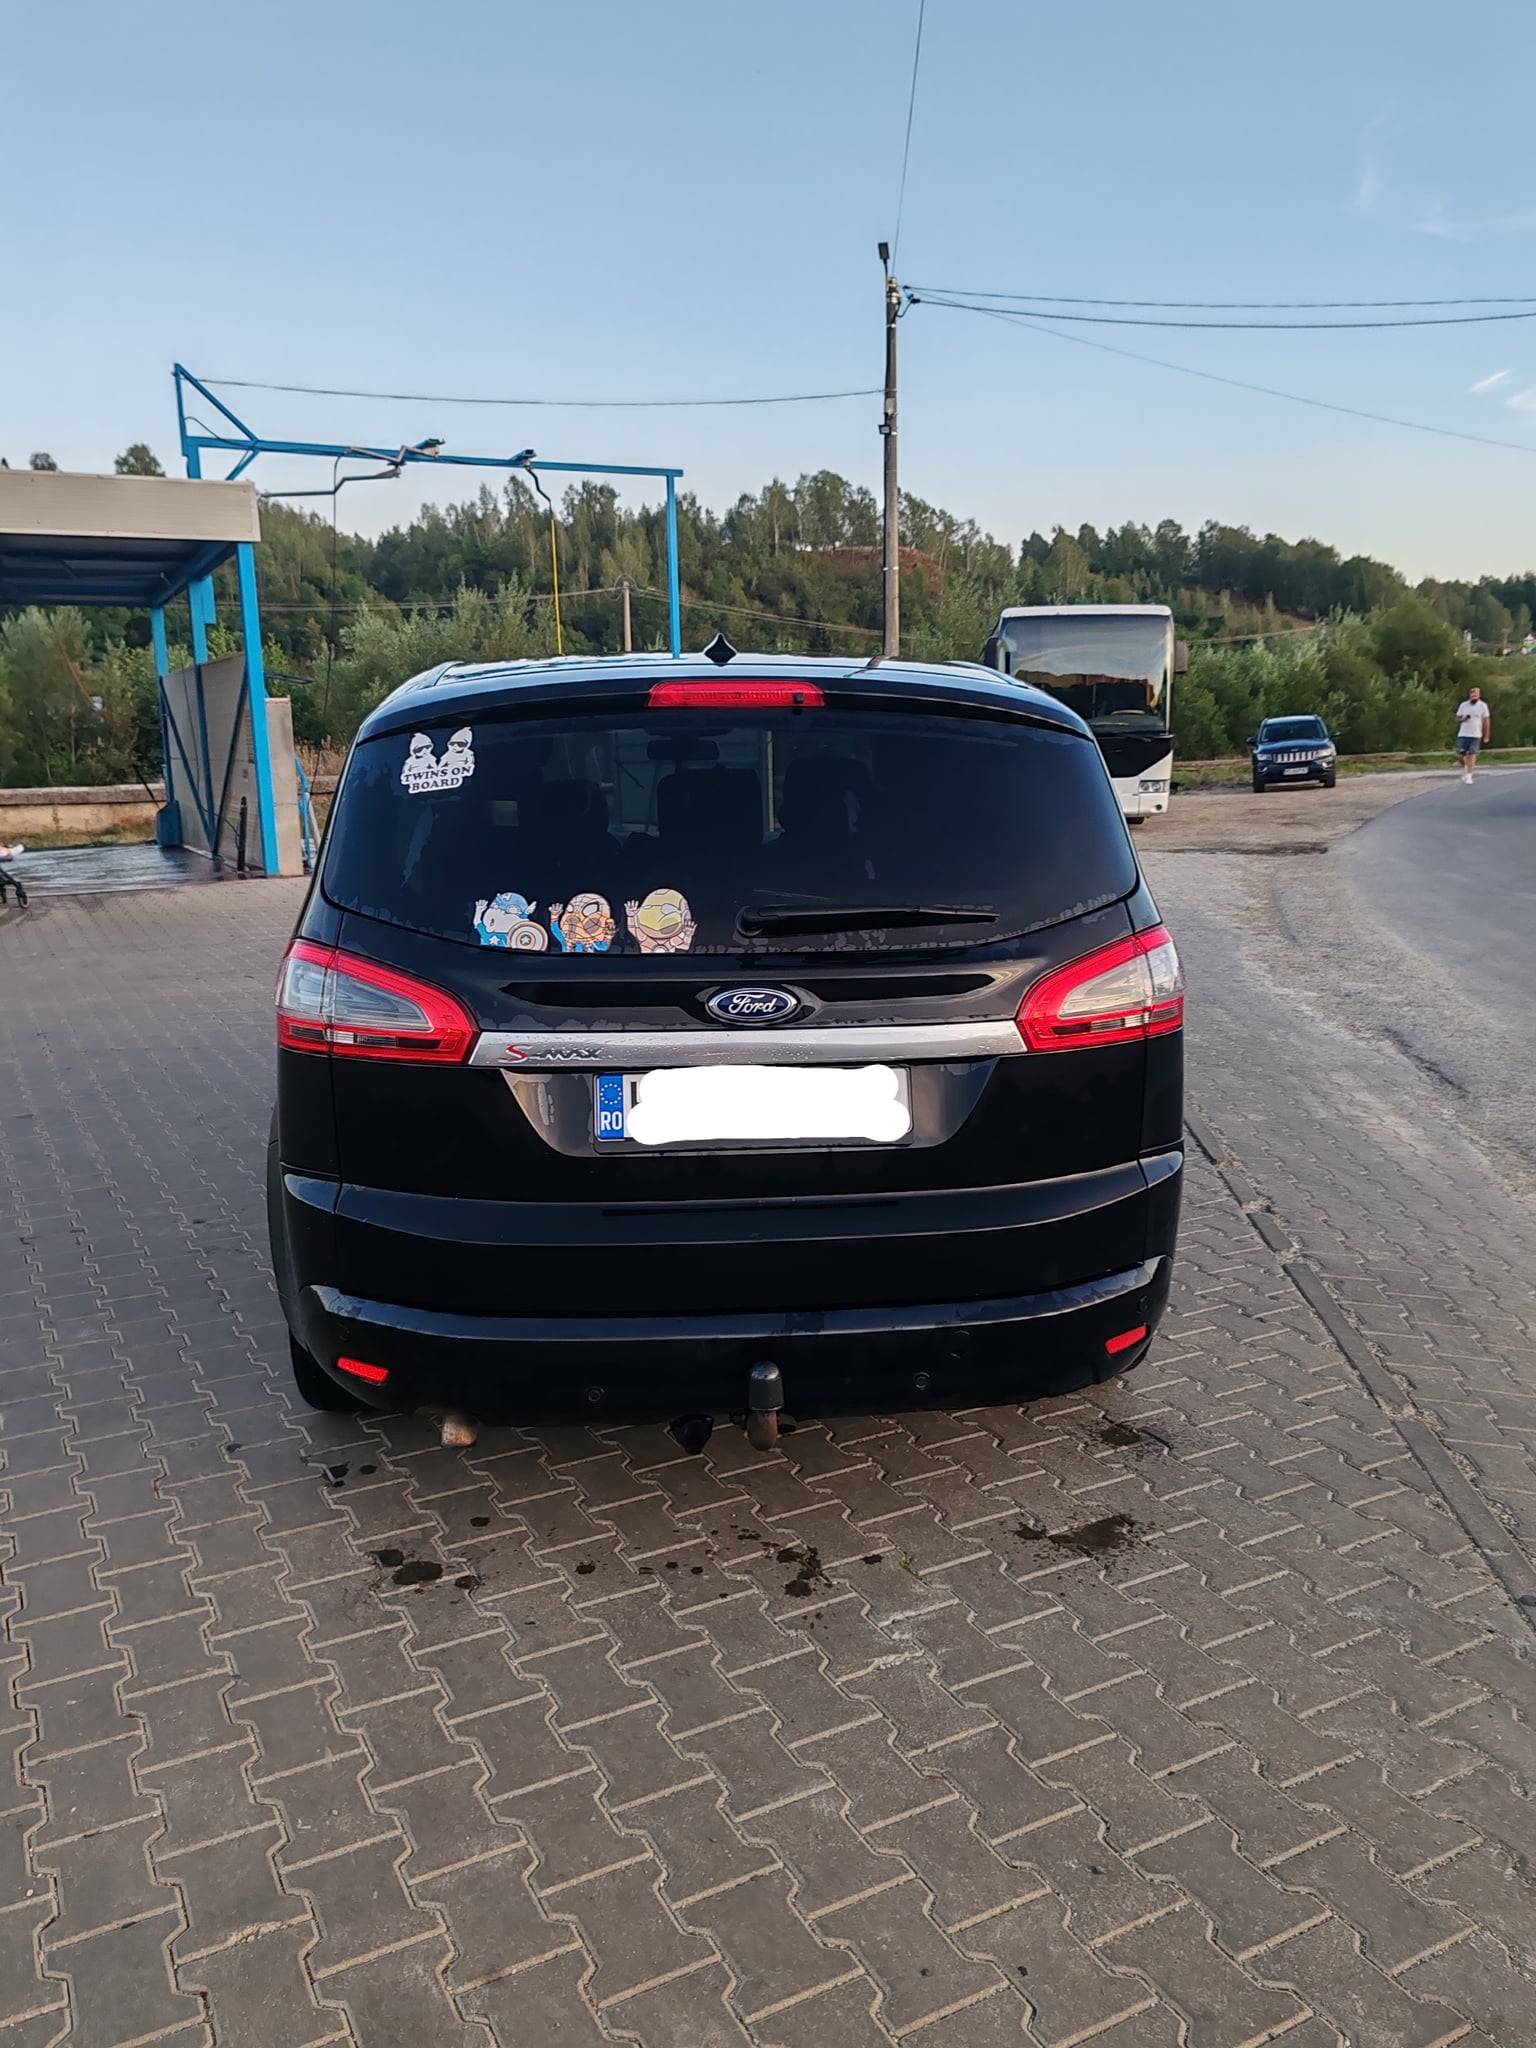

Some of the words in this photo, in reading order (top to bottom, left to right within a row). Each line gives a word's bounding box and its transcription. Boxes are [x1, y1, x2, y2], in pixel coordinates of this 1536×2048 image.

[403, 768, 448, 783] TWINS
[451, 766, 472, 776] ON
[412, 778, 460, 792] BOARD
[728, 994, 777, 1014] Ford
[600, 1111, 623, 1131] RO
